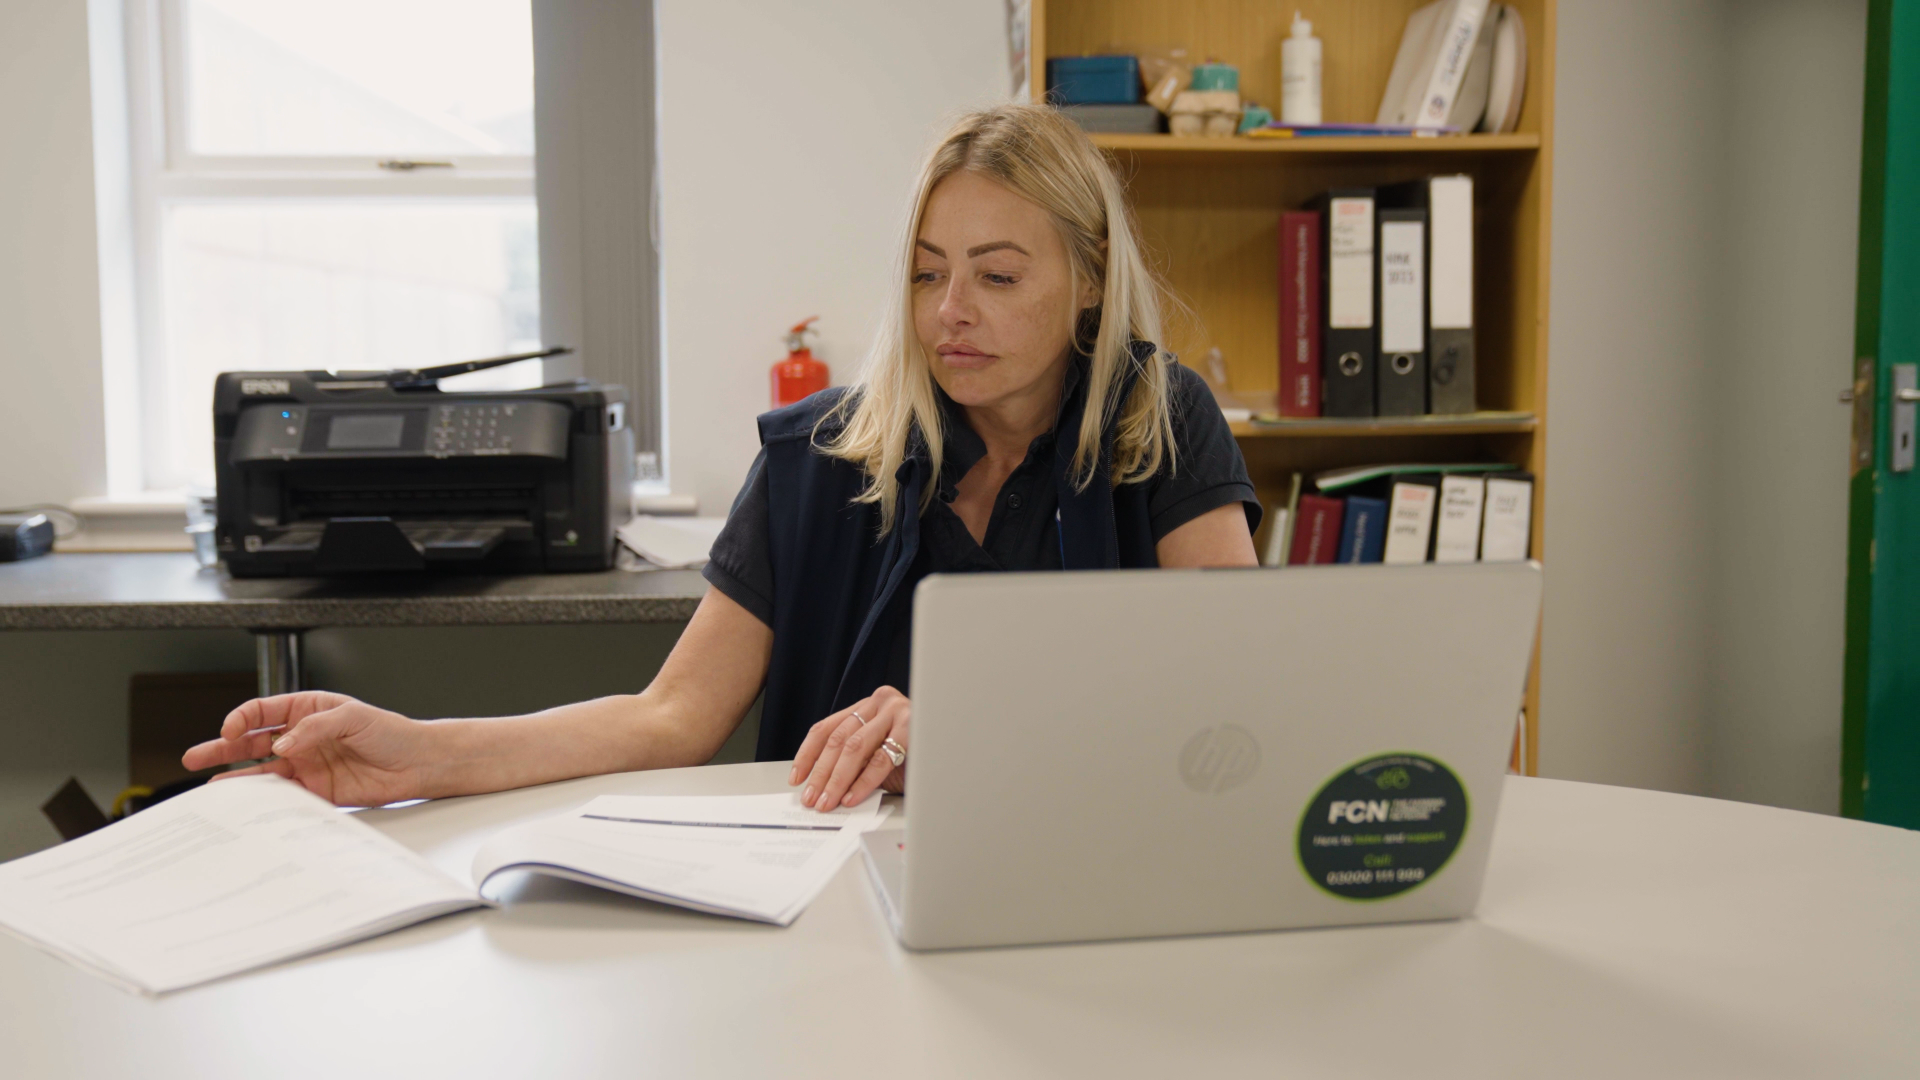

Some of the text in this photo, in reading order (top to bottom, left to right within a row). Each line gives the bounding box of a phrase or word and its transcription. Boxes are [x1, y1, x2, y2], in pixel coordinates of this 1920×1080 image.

[241, 379, 290, 395] EPSON
[1179, 722, 1262, 794] hp
[1328, 800, 1390, 824] FCN
